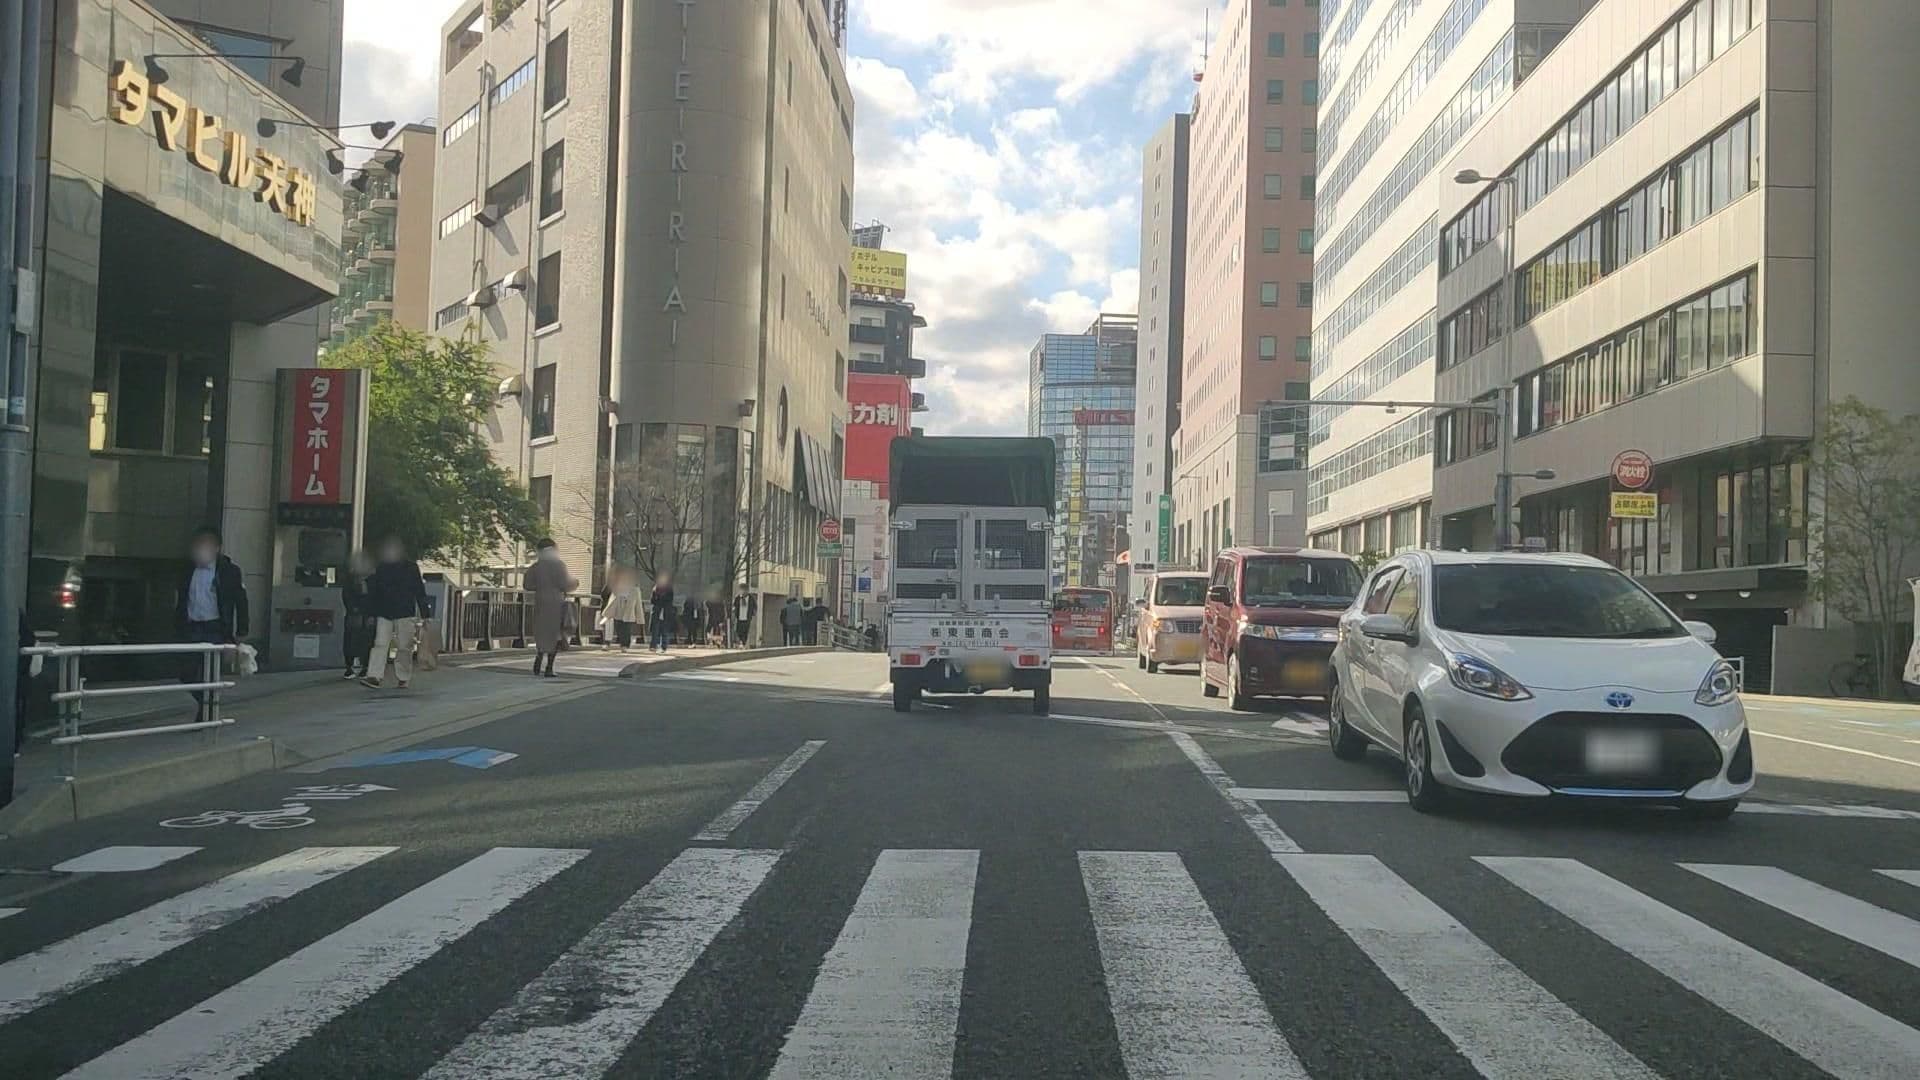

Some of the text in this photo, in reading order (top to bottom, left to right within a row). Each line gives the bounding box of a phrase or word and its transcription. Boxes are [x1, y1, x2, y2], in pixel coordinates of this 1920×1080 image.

[110, 59, 316, 227] タマビル天神
[304, 376, 331, 496] タマホーム
